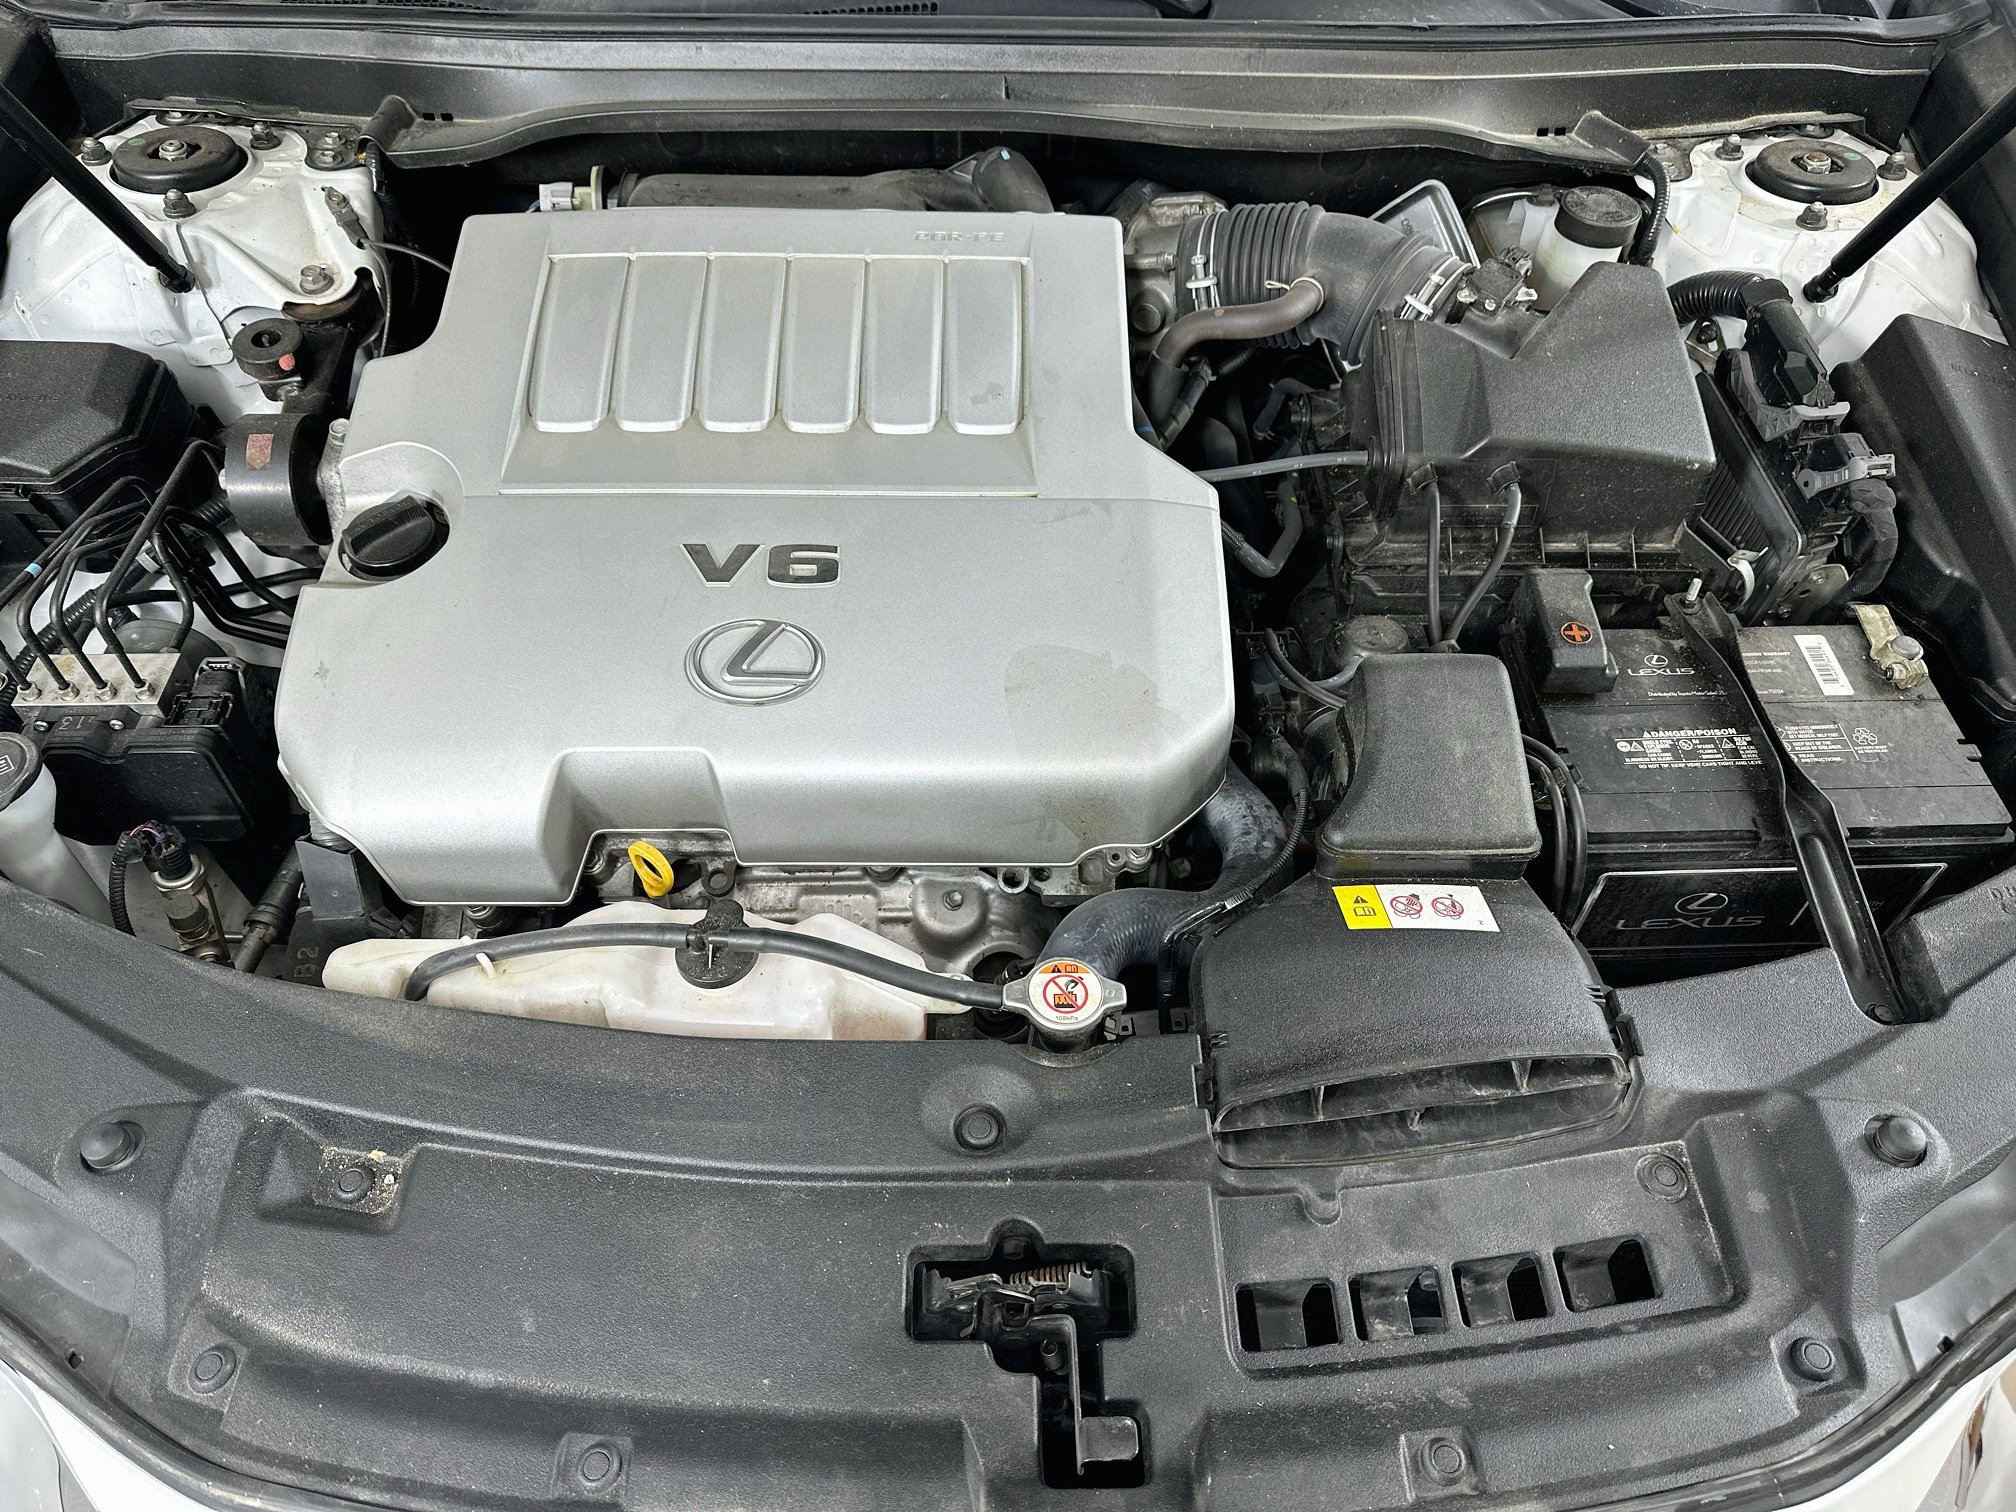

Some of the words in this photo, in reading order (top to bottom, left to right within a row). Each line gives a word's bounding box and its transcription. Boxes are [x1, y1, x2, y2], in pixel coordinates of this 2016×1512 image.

[914, 231, 1005, 242] 2GR-FE
[679, 543, 841, 589] V6
[1627, 668, 1695, 676] LEXUS
[1650, 728, 1737, 738] DANGER/POISON
[1616, 916, 1765, 930] LEXUS
